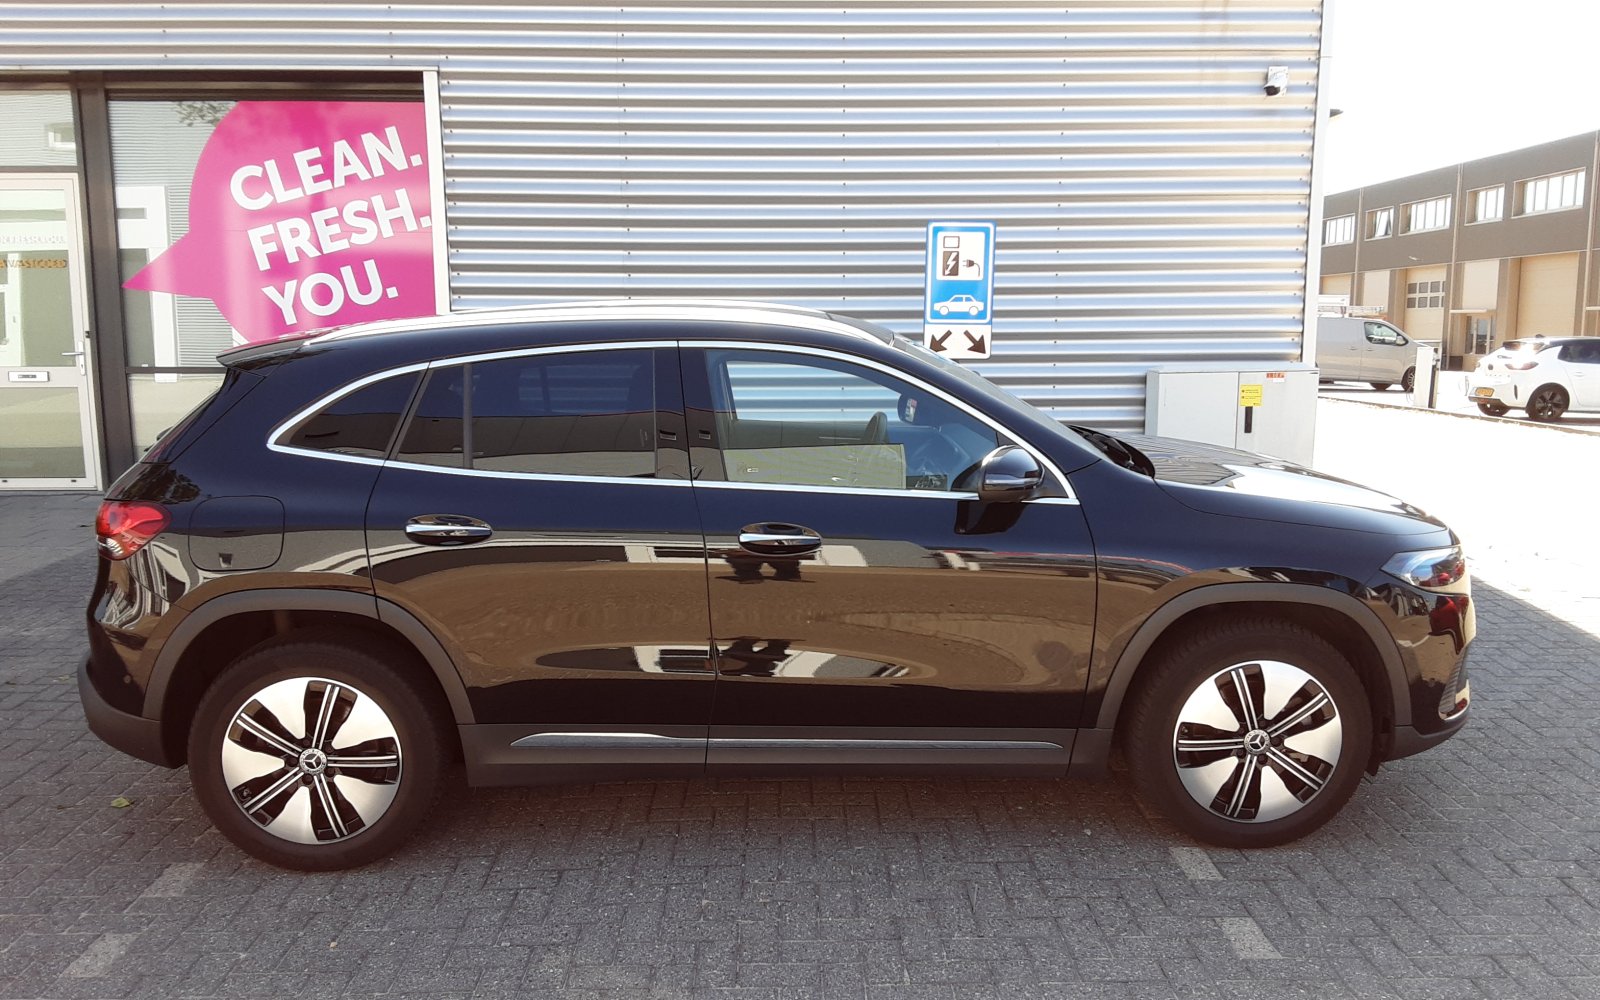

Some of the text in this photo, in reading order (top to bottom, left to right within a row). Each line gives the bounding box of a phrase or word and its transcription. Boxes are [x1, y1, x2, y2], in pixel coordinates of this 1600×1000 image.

[230, 125, 423, 210] CLEAN.
[247, 188, 432, 272] FRESH.
[261, 259, 399, 326] YOU.
